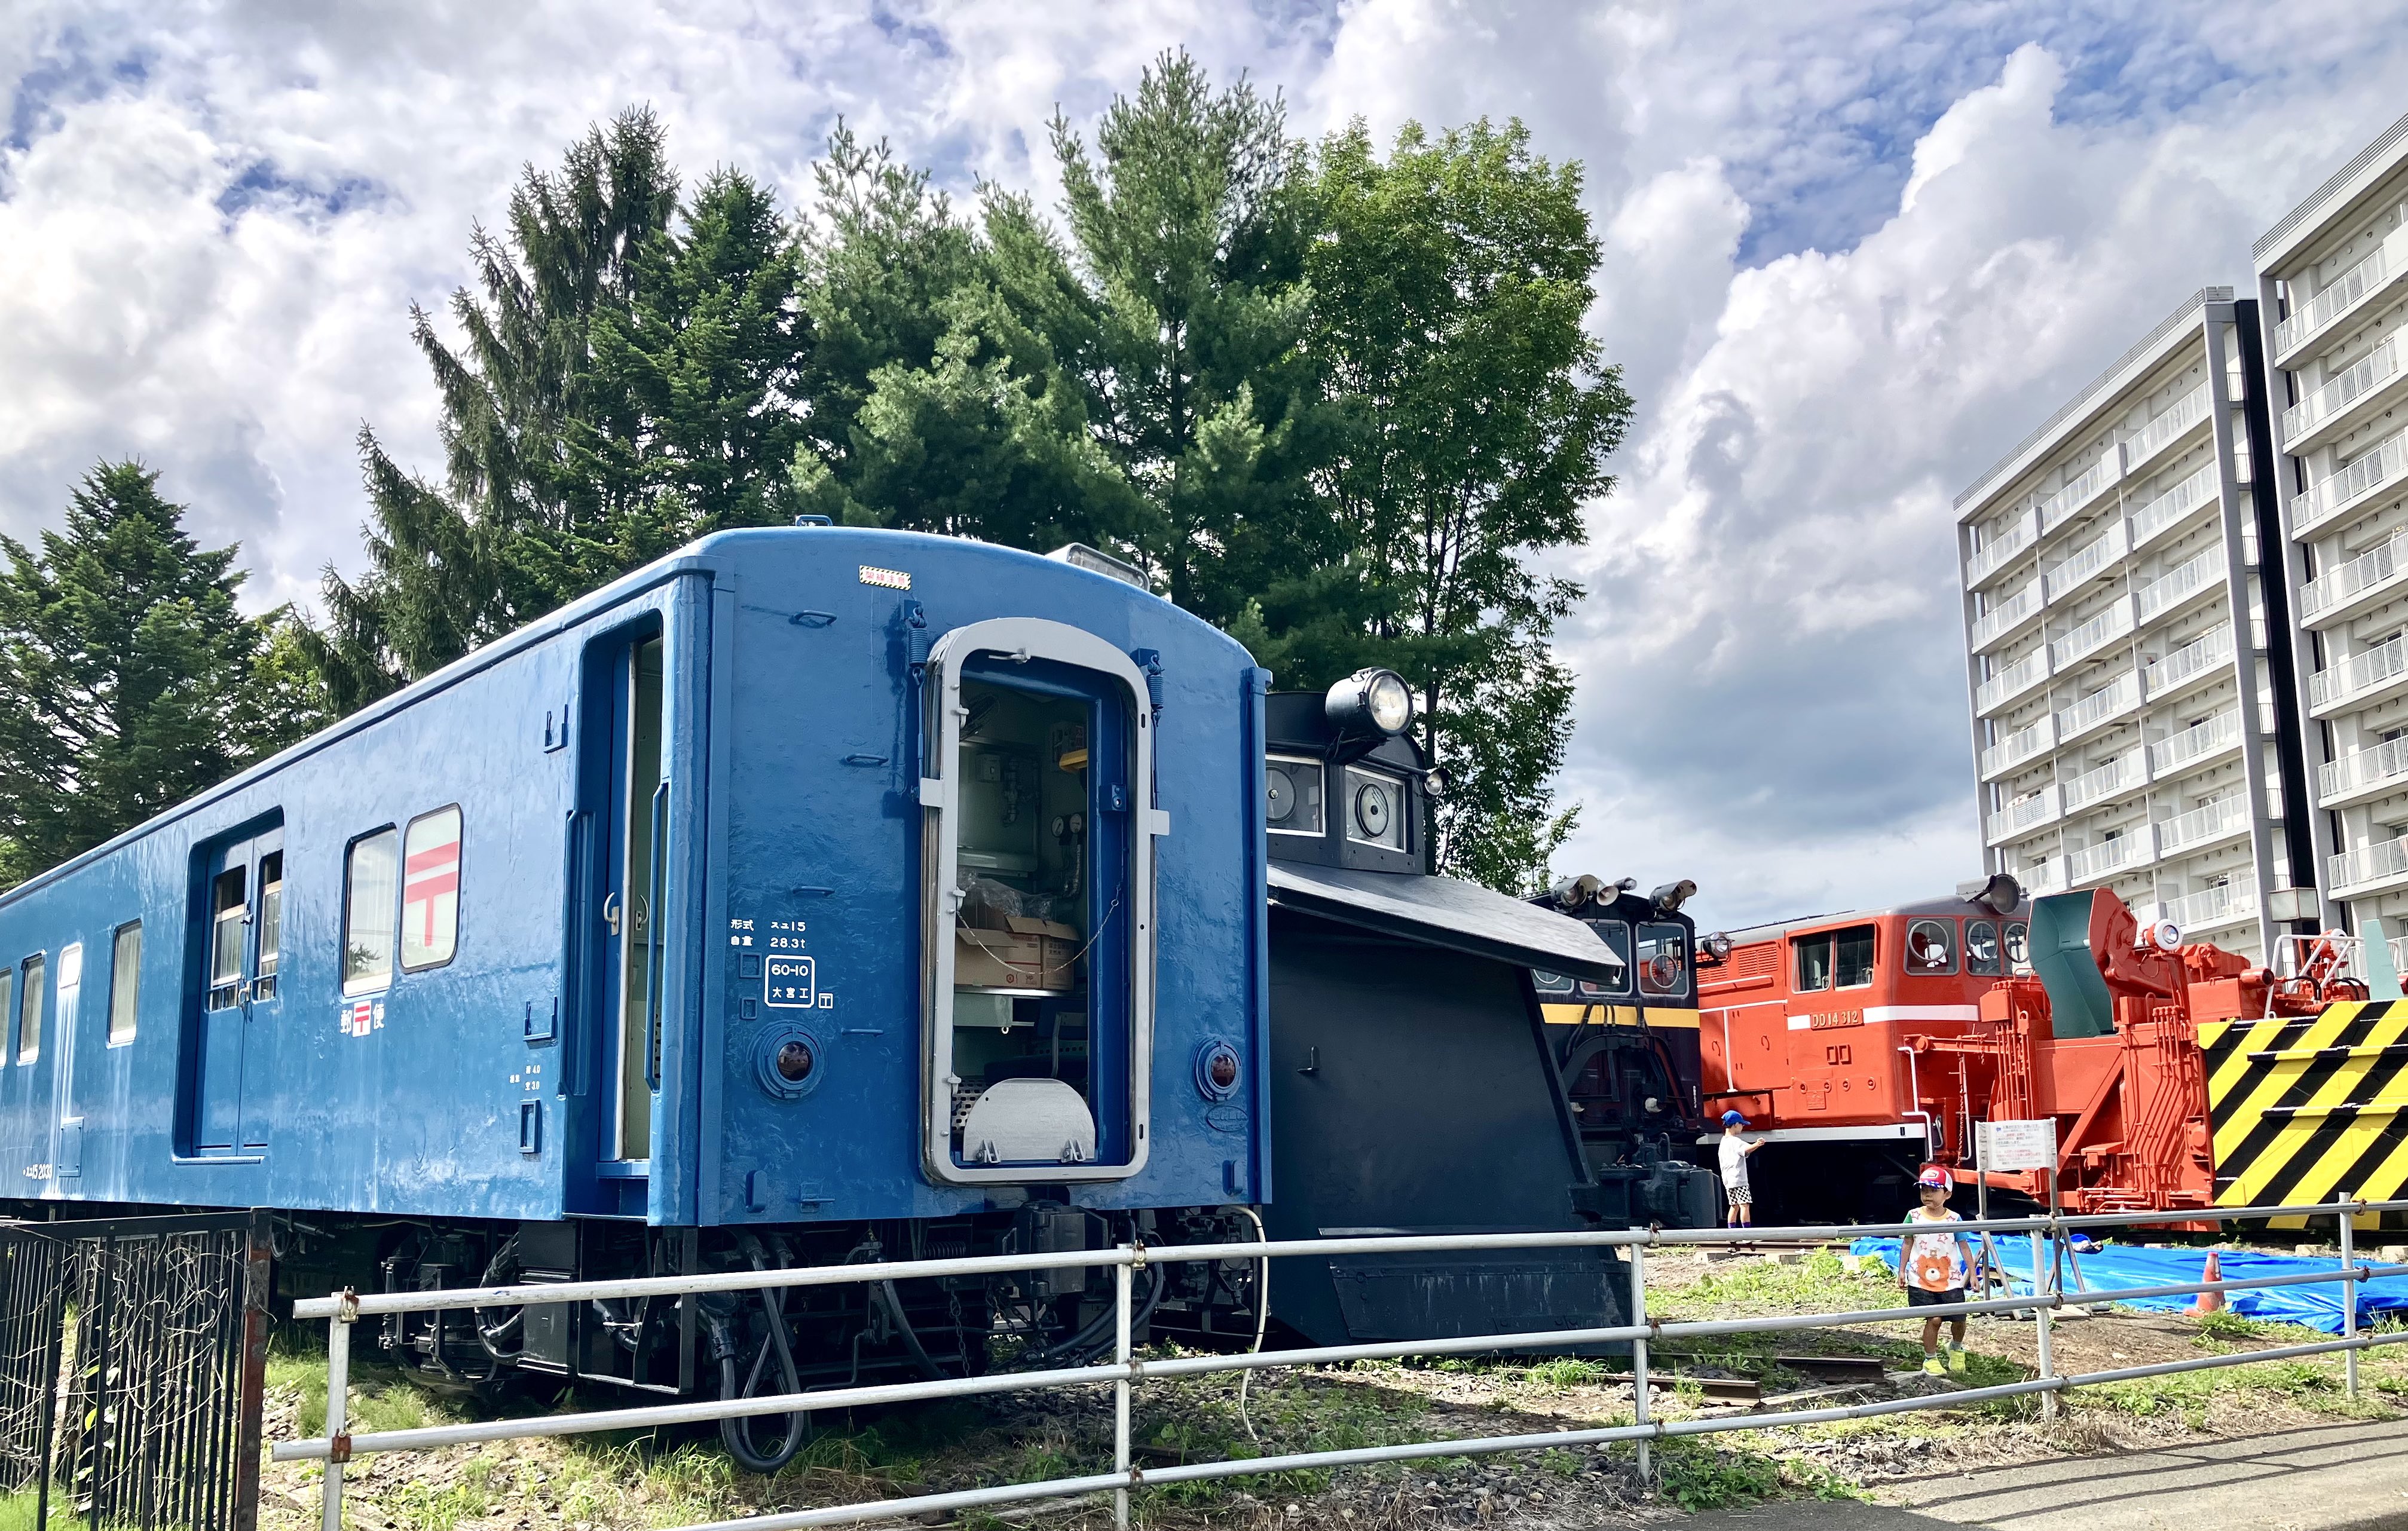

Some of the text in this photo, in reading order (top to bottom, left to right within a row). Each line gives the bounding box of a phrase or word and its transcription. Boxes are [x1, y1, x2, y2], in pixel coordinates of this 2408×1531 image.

[730, 918, 806, 932] 形式 スユ15
[730, 935, 806, 948] 自重 28.3t
[771, 964, 809, 976] 60-10
[772, 986, 809, 999] 大宮工
[1841, 1010, 1858, 1024] 312
